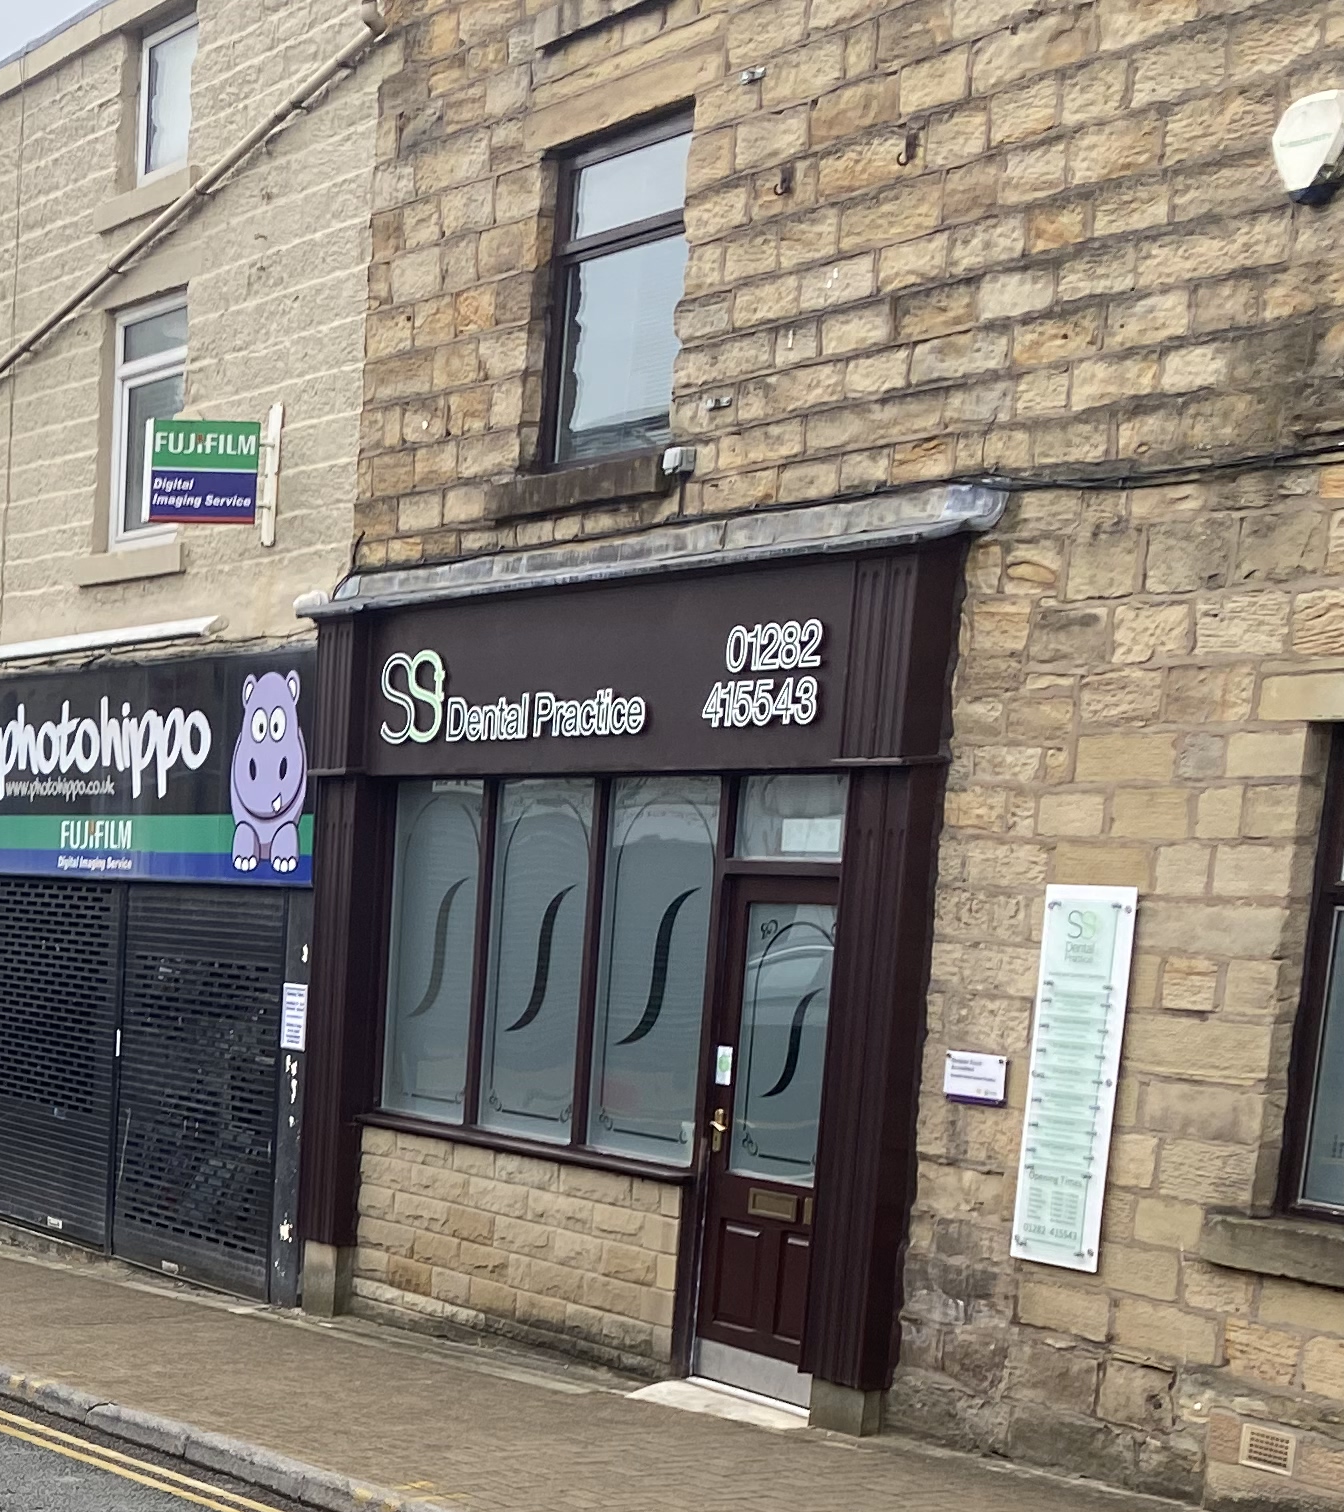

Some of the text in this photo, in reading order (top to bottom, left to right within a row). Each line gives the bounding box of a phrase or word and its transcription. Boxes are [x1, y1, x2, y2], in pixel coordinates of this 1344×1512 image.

[154, 431, 256, 455] FUJIFILM
[153, 477, 195, 492] Digital
[152, 493, 252, 508] Imaging Service
[726, 618, 824, 674] 01282
[702, 676, 819, 728] 415543
[445, 692, 530, 743] Dental
[532, 687, 646, 740] Practice
[5, 775, 116, 802] www.photohippo.co.uk
[60, 819, 133, 850] FUJIFILM
[57, 855, 133, 871] Digital Imaging Service
[1065, 941, 1096, 954] Dental
[1028, 1170, 1083, 1188] Opening Times
[1023, 1222, 1046, 1236] 01282
